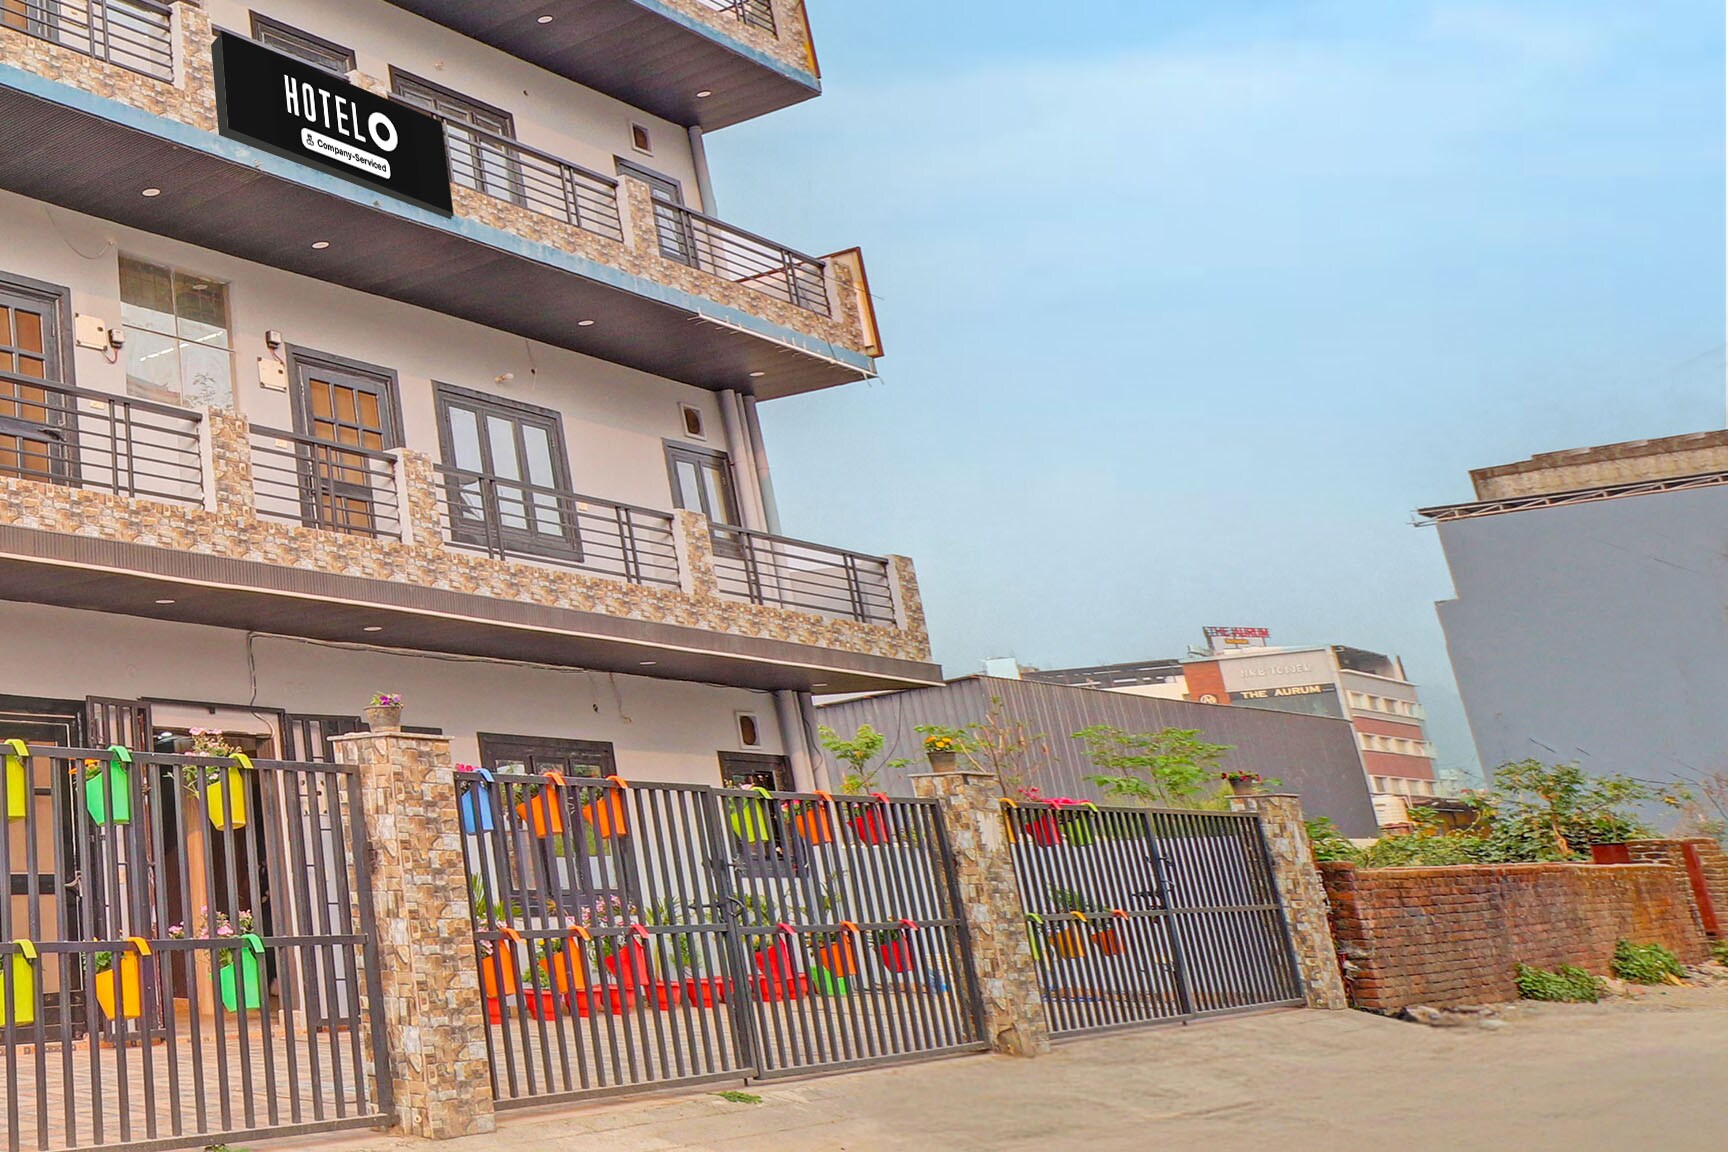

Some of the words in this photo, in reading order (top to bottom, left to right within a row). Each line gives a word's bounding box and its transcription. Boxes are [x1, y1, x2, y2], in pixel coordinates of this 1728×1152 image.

[317, 139, 387, 173] Company-Serviced
[1240, 690, 1268, 699] THE
[1274, 685, 1322, 697] AURUM
